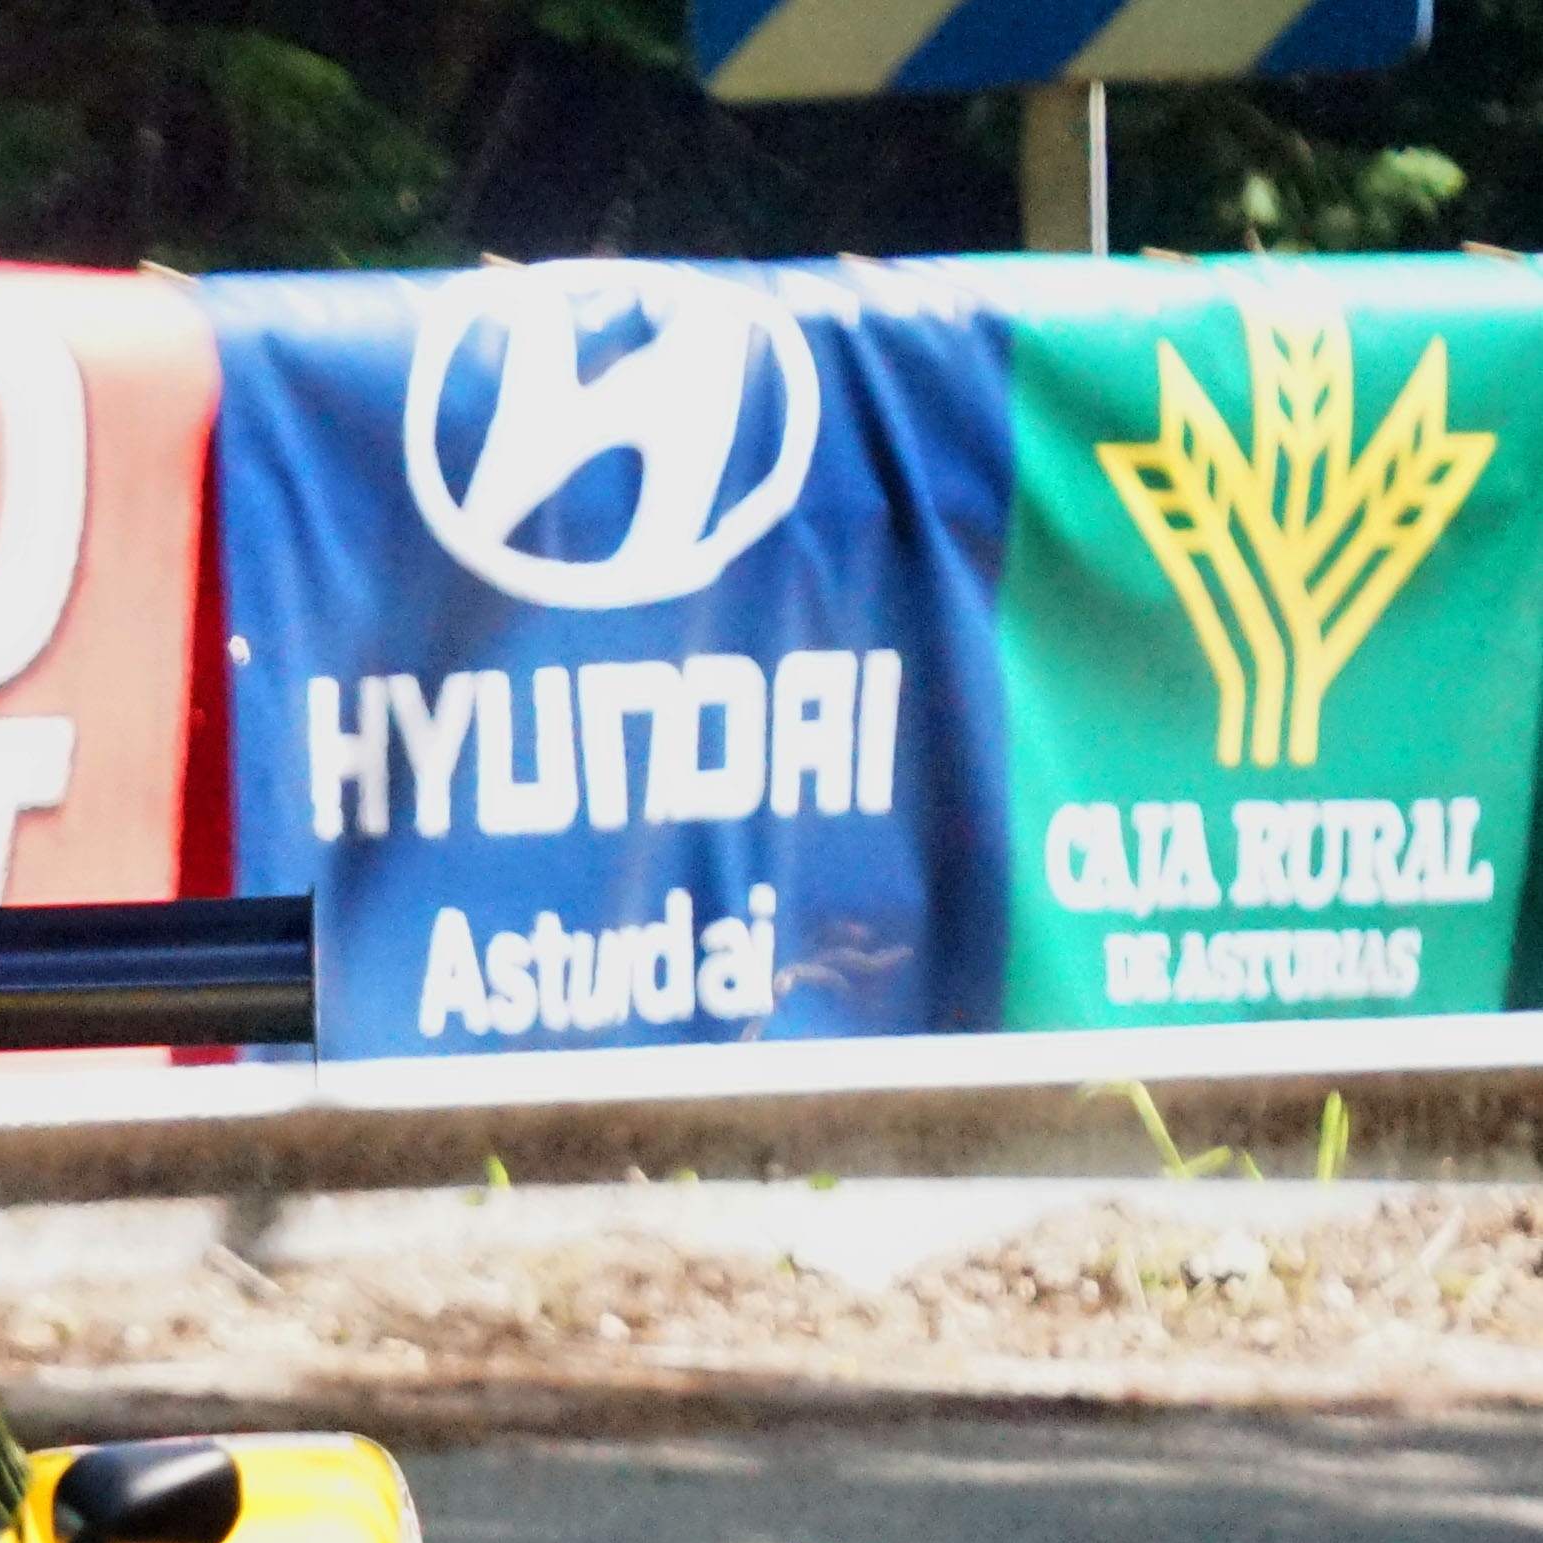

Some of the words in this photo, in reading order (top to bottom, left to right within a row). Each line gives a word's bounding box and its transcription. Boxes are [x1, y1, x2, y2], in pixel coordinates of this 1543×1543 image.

[307, 648, 903, 840] HYUNDAI
[1046, 802, 1220, 914] CAJA
[1230, 797, 1493, 908] RURAL
[1104, 932, 1172, 1003] DE
[1174, 929, 1423, 1002] ASTURIAS
